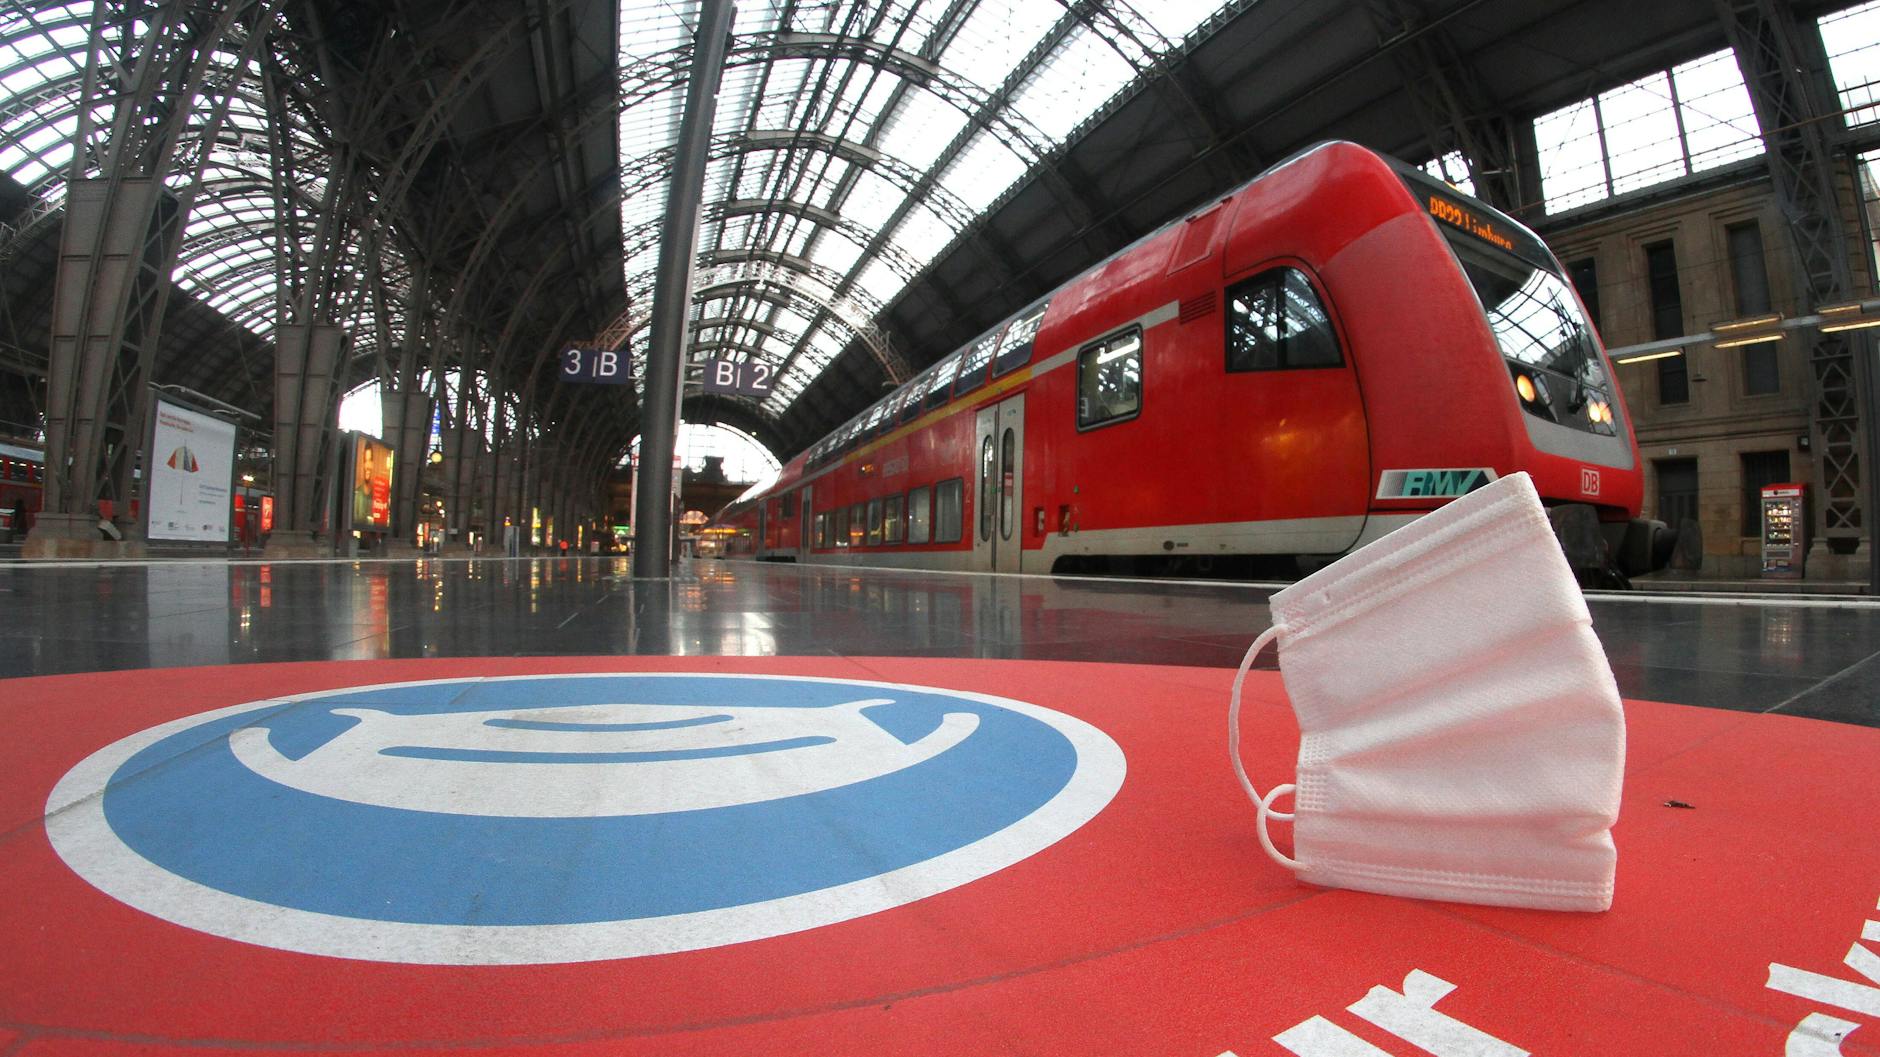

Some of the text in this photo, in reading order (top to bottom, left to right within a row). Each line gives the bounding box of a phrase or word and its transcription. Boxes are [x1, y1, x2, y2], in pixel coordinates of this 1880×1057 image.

[564, 349, 618, 377] 3 B
[715, 360, 770, 390] B 2
[1402, 469, 1483, 497] RMV
[1582, 471, 1599, 493] DB
